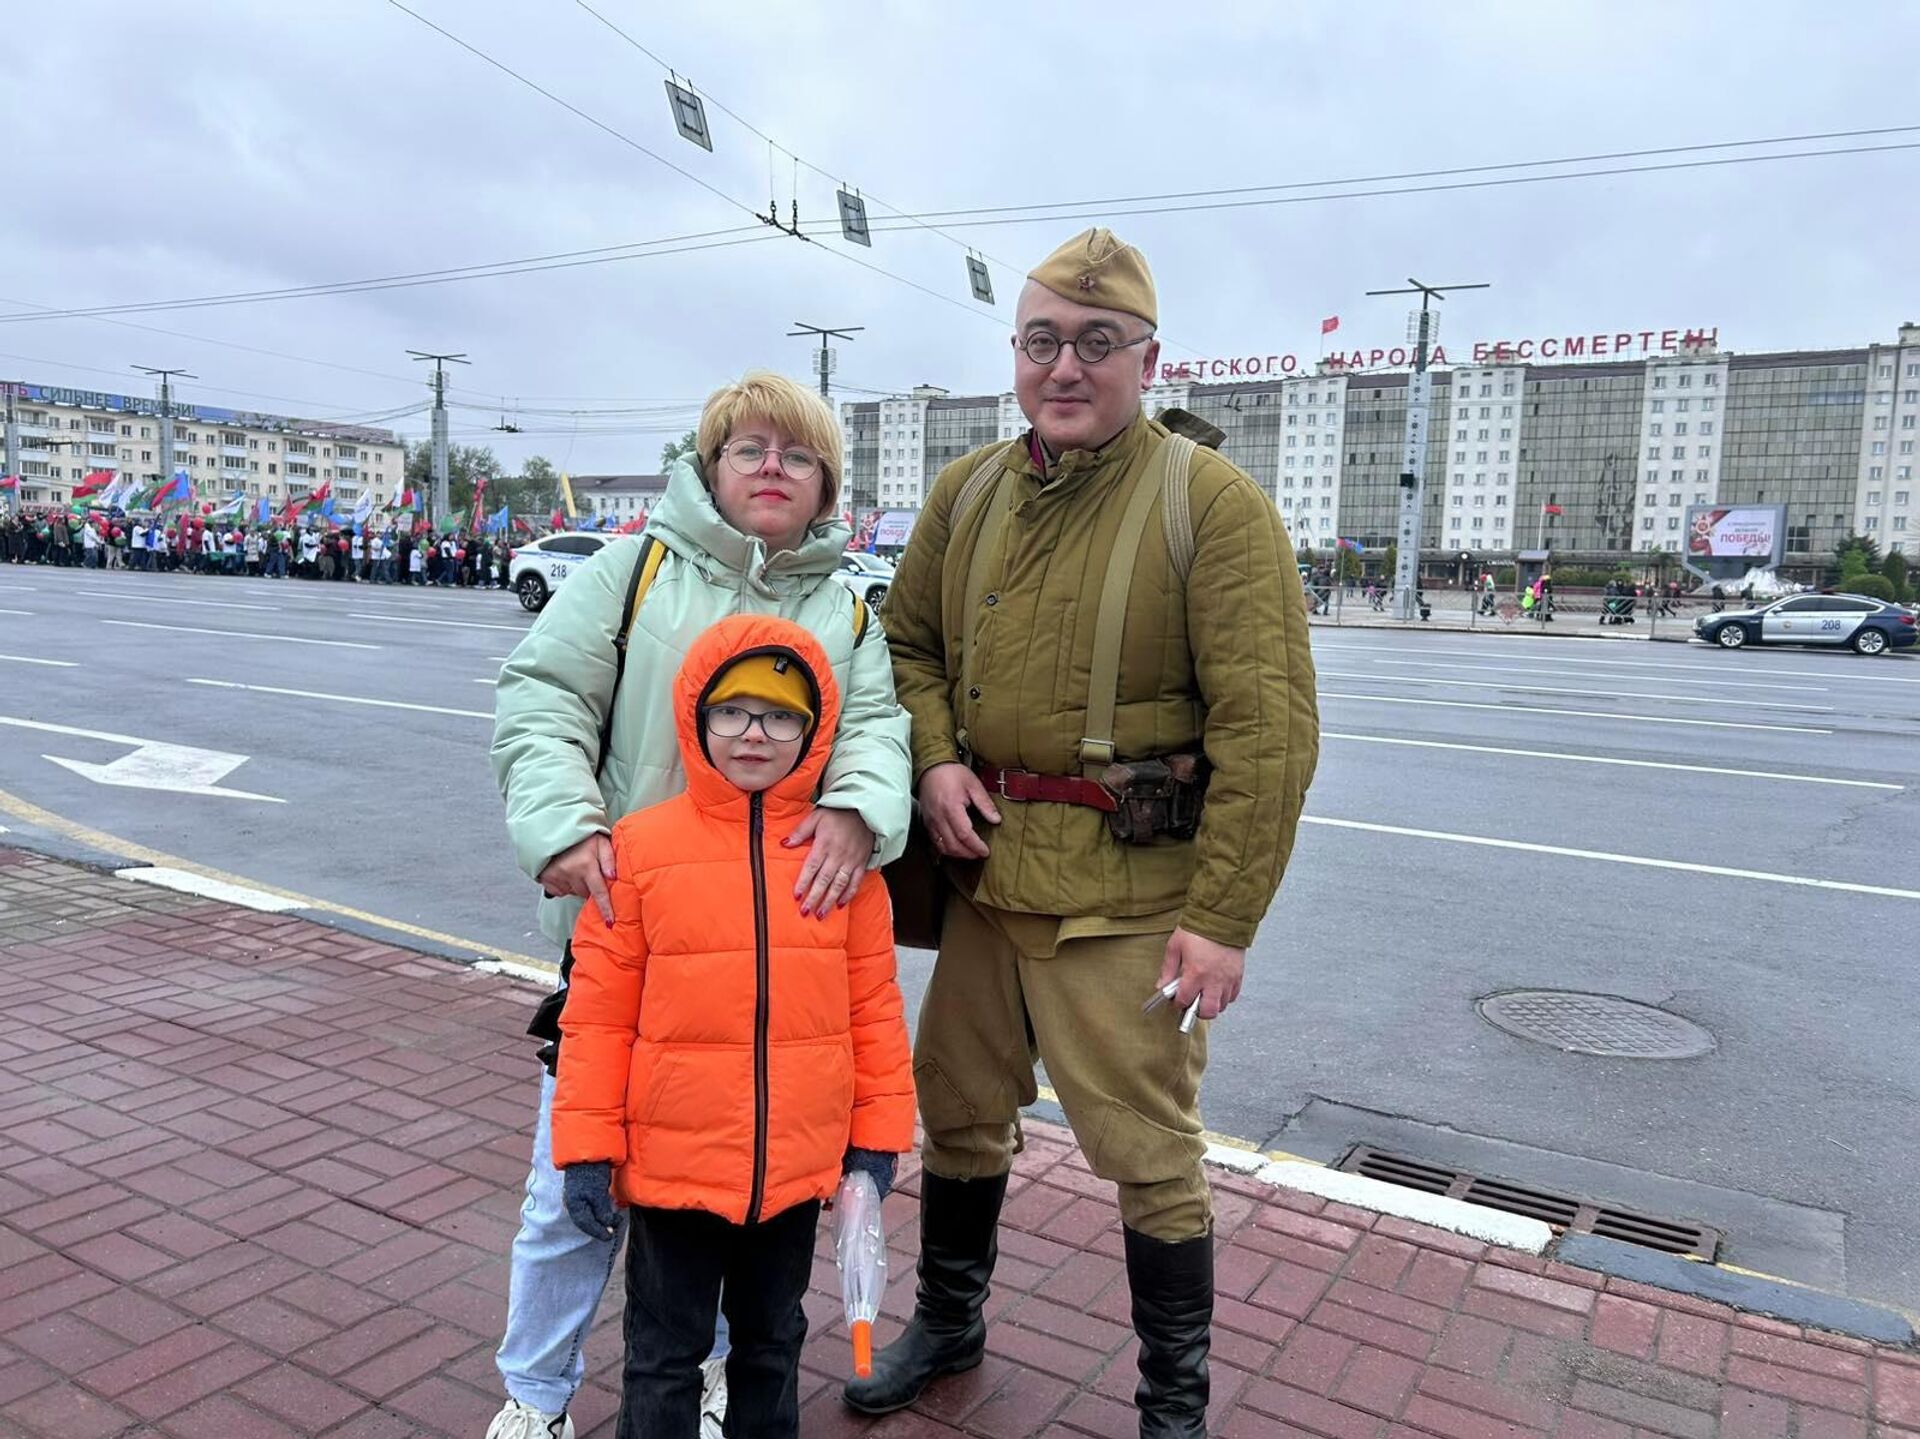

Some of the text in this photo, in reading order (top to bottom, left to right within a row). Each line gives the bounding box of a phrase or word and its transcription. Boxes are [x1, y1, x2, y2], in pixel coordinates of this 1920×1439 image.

[1161, 328, 1717, 379] ВЕТСКОГО НАРОДА БЕССМЕРТЕН!
[40, 386, 112, 407] СИЛЬНЕЕ
[123, 396, 196, 416] ВРЕМНИ!
[1720, 533, 1772, 543] ПОБЕДЫ!
[551, 563, 567, 578] 218
[1822, 619, 1841, 630] 208
